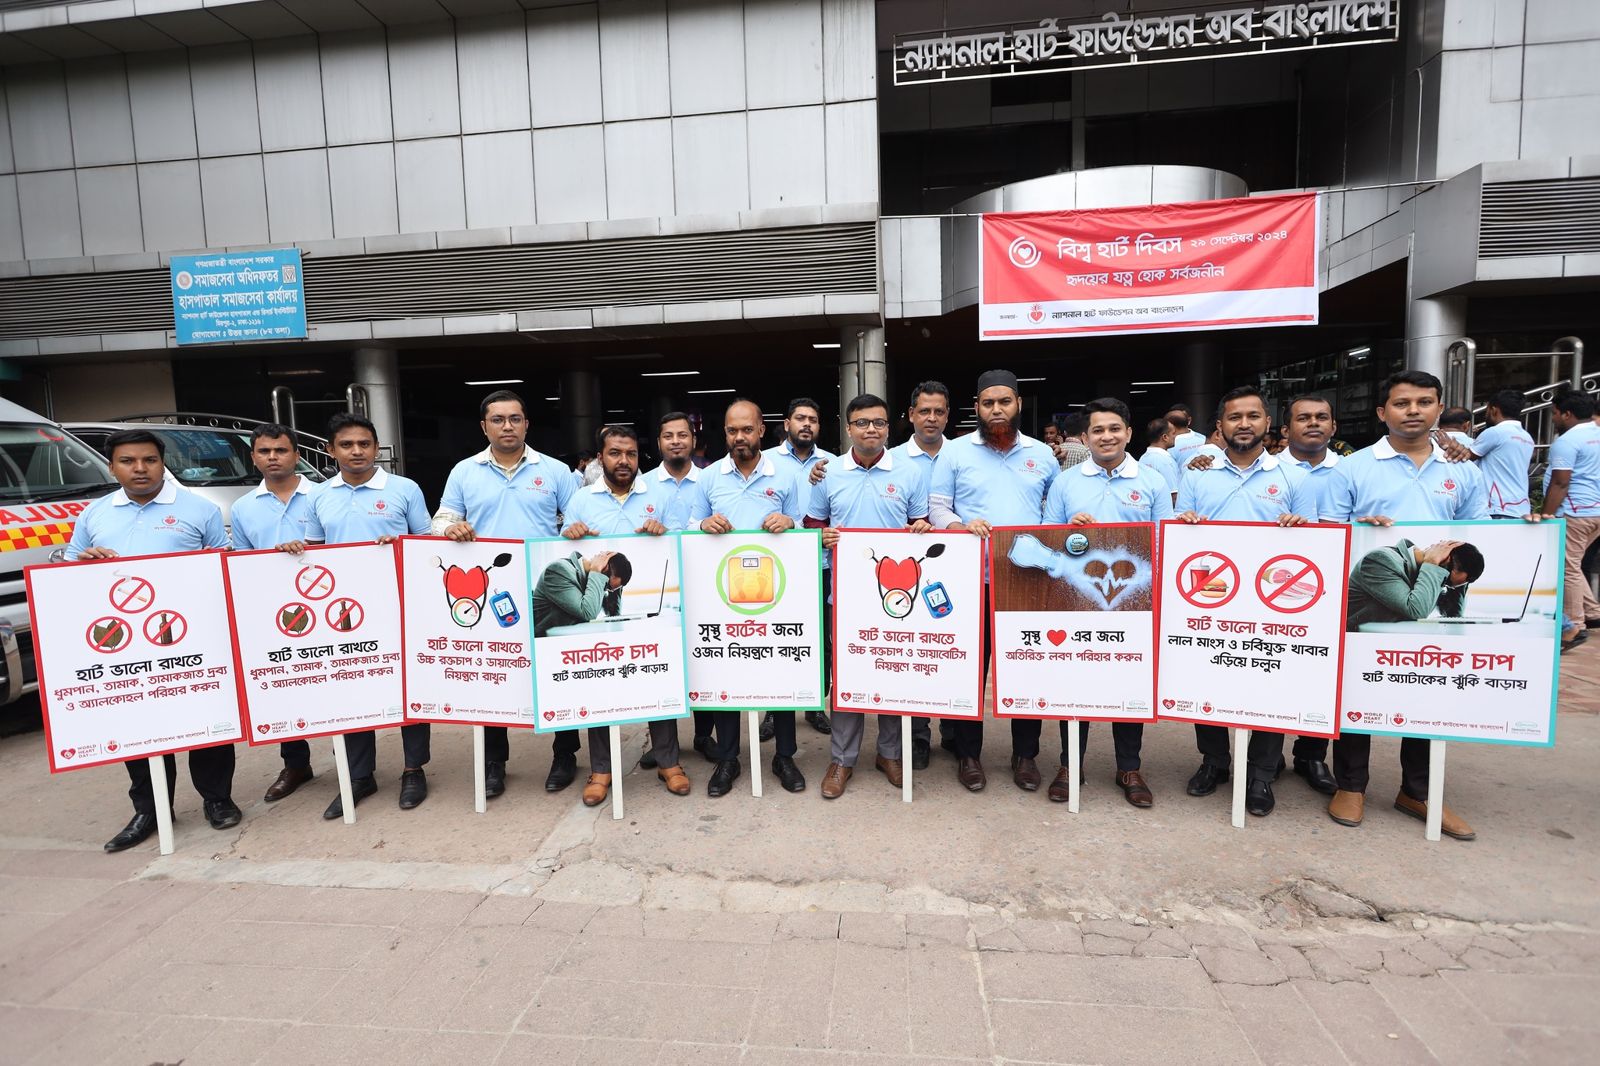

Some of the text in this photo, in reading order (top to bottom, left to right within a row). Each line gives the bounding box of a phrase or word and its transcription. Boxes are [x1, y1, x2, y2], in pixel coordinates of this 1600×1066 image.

[902, 31, 1005, 71] ন্যাশনাল
[1013, 17, 1059, 64] হার্ট
[1204, 7, 1255, 44] অব
[1262, 0, 1391, 39] বাংলাদেশ
[1056, 232, 1182, 263] বিশ্ব হার্ট দিবস
[1190, 230, 1287, 248] ২৯ সেপ্টেম্বর ২০২৪
[193, 267, 279, 287] সমাজসেবা অধিদফতর
[1066, 262, 1225, 286] হৃদয়ের যত্ন হোক সর্বজনীন
[178, 286, 298, 310] হাসপাতাল সমাজসেবা কার্যালয়
[698, 620, 804, 642] সুস্থ হার্টের জন্য
[858, 627, 955, 645] হার্ট ভালো রাখতে
[1071, 630, 1125, 642] এর জন্য
[1187, 616, 1308, 638] হার্ট ভালো রাখতে
[427, 636, 523, 654] হার্ট ভালো রাখতে
[1021, 630, 1041, 645] সুস্থ
[1168, 635, 1329, 657] লাল মাংস ও চর্বিযুক্ত খাবার
[268, 640, 378, 663] হার্ট ভালো রাখতে
[417, 652, 435, 664] উচ্চ
[438, 656, 472, 666] রক্তচাপ
[475, 658, 482, 666] ও
[561, 642, 658, 665] মানসিক চাপ
[692, 642, 811, 662] ওজন নিয়ন্ত্রণে রাখুন
[848, 643, 966, 660] উচ্চ রক্তচাপ ও ডায়াবেটিস
[1005, 648, 1142, 662] অতিরিক্ত লবণ পরিহার করুন
[1376, 645, 1515, 672] মানসিক চাপ
[76, 653, 203, 682] হার্ট ভালো রাখতে
[292, 661, 327, 674] তামাক,
[330, 655, 379, 668] তামাকজাত
[552, 663, 668, 682] হার্ট অ্যাটাকের ঝুঁকি বাড়ায়
[875, 658, 938, 676] নিয়ন্ত্রণে রাখুন
[1210, 652, 1281, 673] এড়িয়ে চলুন
[104, 677, 144, 691] তামাক,
[147, 668, 204, 686] তামাকজাত
[207, 666, 227, 678] দ্রব্য
[260, 666, 394, 690] ও অ্যালকোহল পরিহার করুন
[444, 668, 506, 685] নিয়ন্ত্রণে রাখুন
[1362, 670, 1527, 690] হার্ট অ্যাটাকের ঝুঁকি বাড়ায়
[65, 681, 220, 711] ও অ্যালকোহল পরিহার করুন
